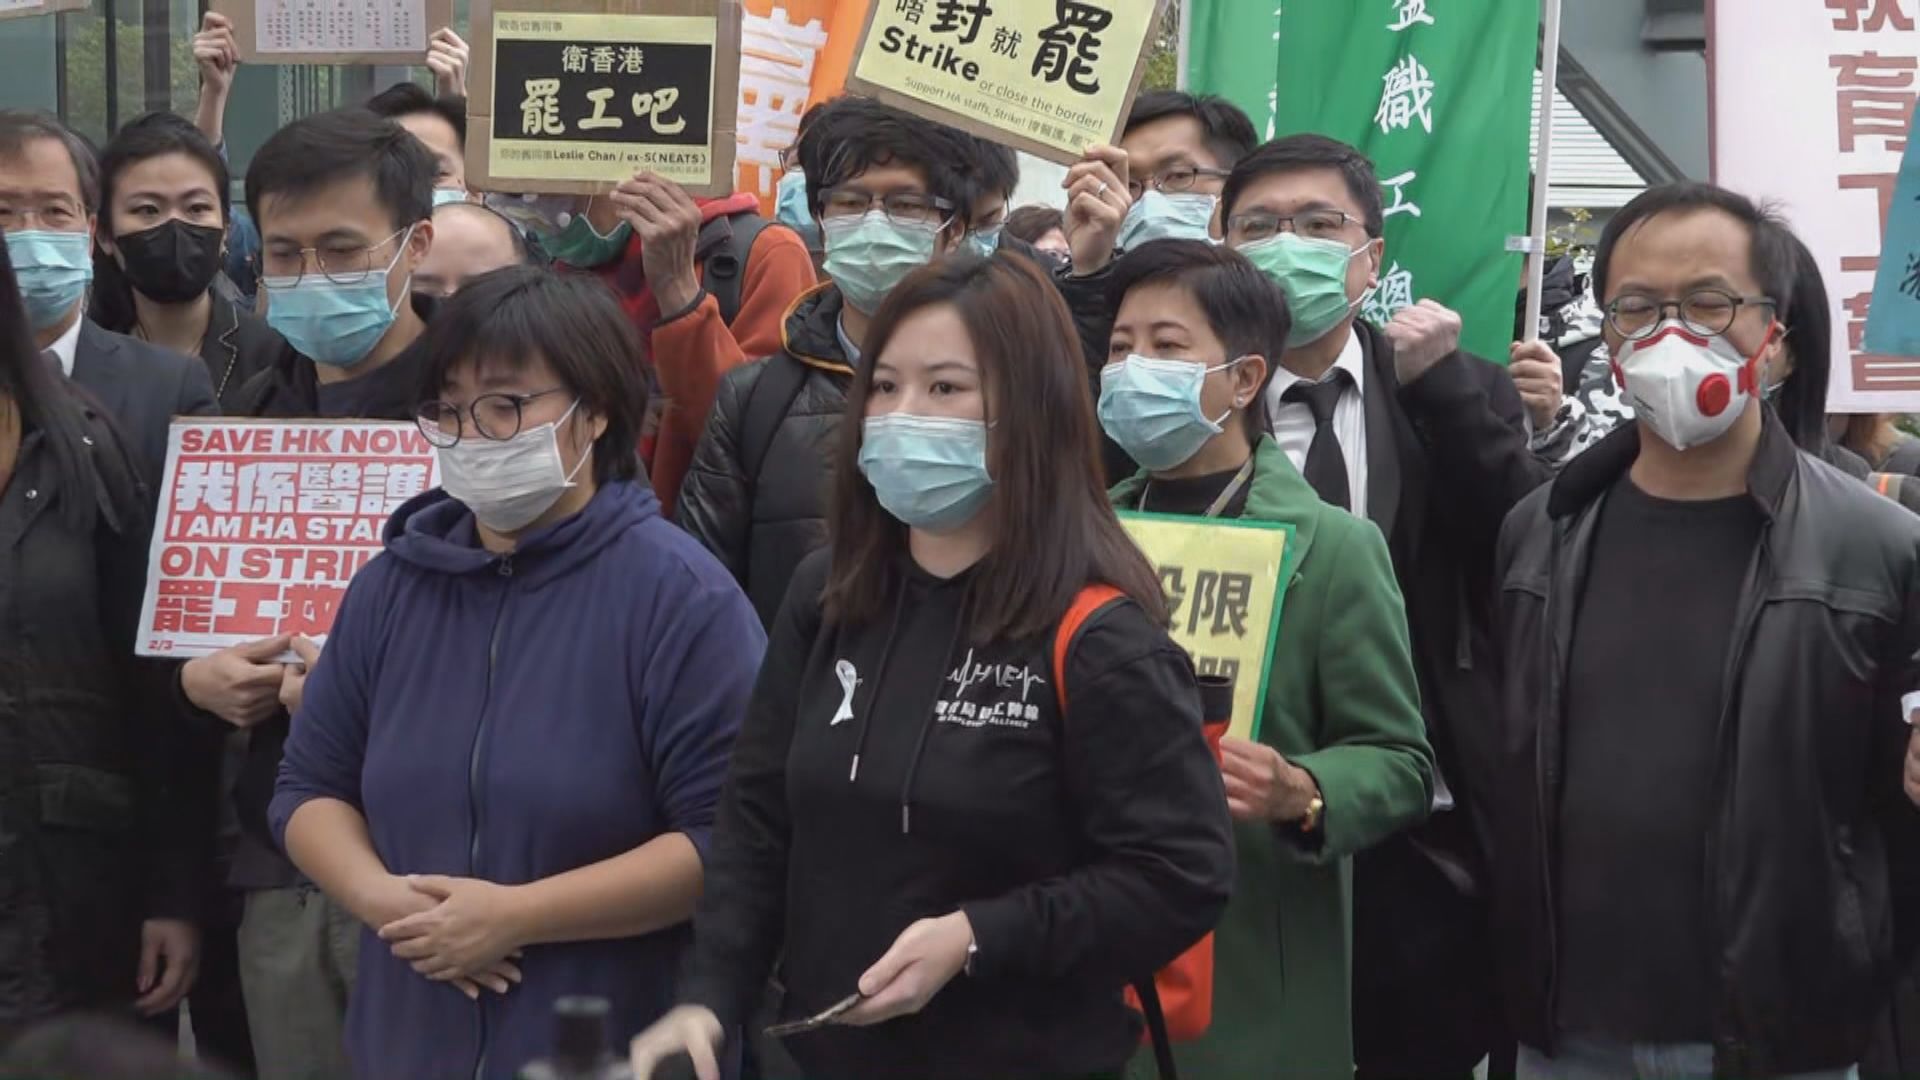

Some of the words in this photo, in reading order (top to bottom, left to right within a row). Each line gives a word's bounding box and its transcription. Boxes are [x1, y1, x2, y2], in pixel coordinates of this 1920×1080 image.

[562, 45, 643, 73] 衛香港
[879, 25, 980, 82] Strike
[519, 78, 686, 135] 罷工吧
[904, 77, 944, 98] Support
[944, 91, 961, 103] HA
[994, 108, 1026, 127] Strike!
[979, 80, 994, 92] or
[996, 83, 1029, 106] close
[1031, 93, 1053, 112] the
[1055, 104, 1104, 129] border!
[553, 149, 584, 161] Leslie
[588, 150, 616, 161] Chan
[619, 151, 624, 161] /
[181, 428, 275, 454] SAVE
[280, 428, 340, 454] HK
[341, 428, 432, 454] NOW
[175, 460, 427, 514] 我係醫護
[169, 515, 181, 538] I
[186, 515, 241, 539] AM
[249, 516, 297, 540] HA
[159, 546, 230, 577] ON
[147, 639, 174, 651] 2/3
